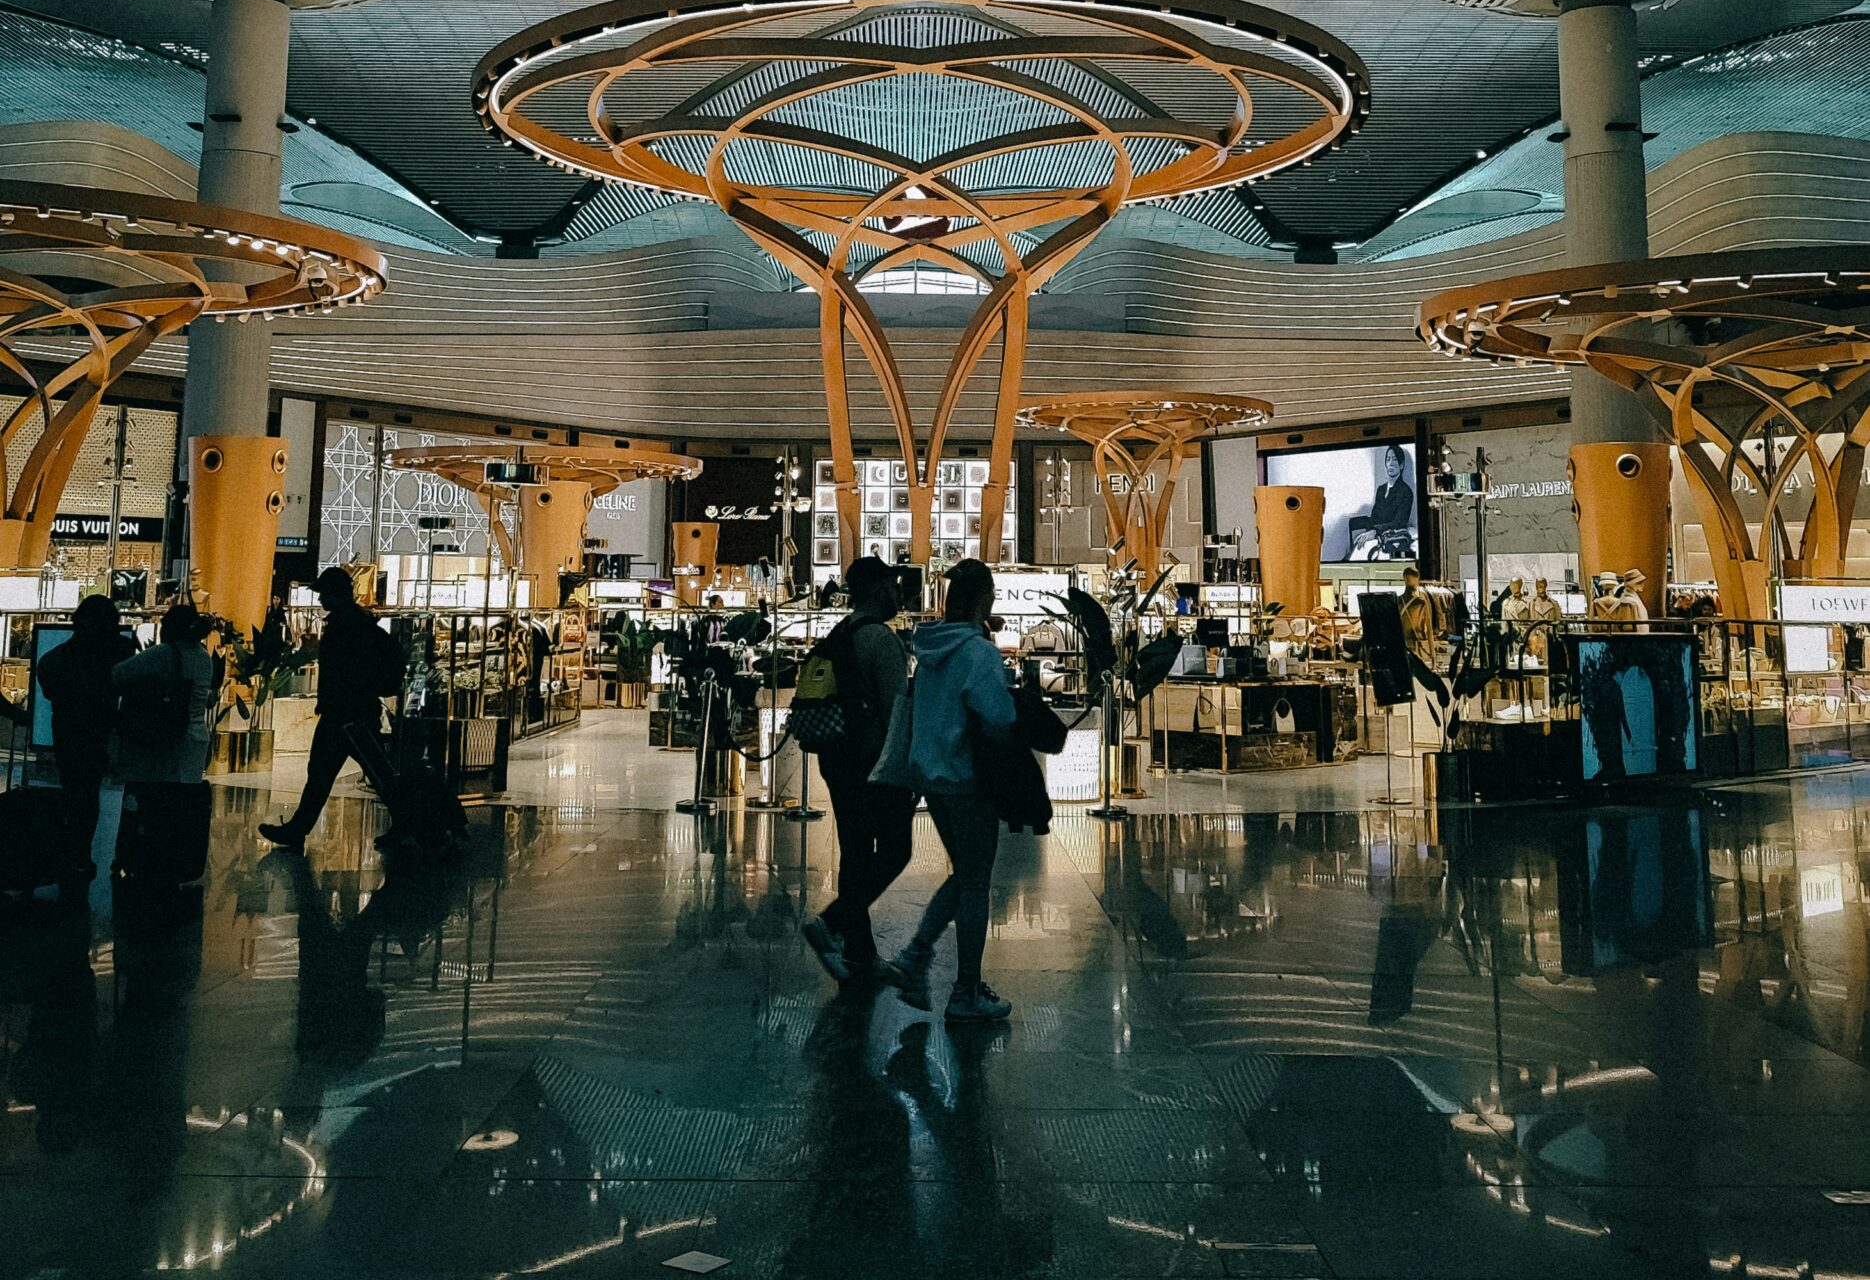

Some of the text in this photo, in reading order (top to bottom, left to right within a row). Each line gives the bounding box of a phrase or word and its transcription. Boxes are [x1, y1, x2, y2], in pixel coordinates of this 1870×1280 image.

[418, 481, 468, 508] DIOR
[1522, 480, 1574, 497] LAUREN
[593, 493, 637, 511] CELINE
[718, 505, 771, 520] Loro Piana
[50, 519, 139, 535] UIS VUITON
[995, 589, 1064, 600] ENCHY
